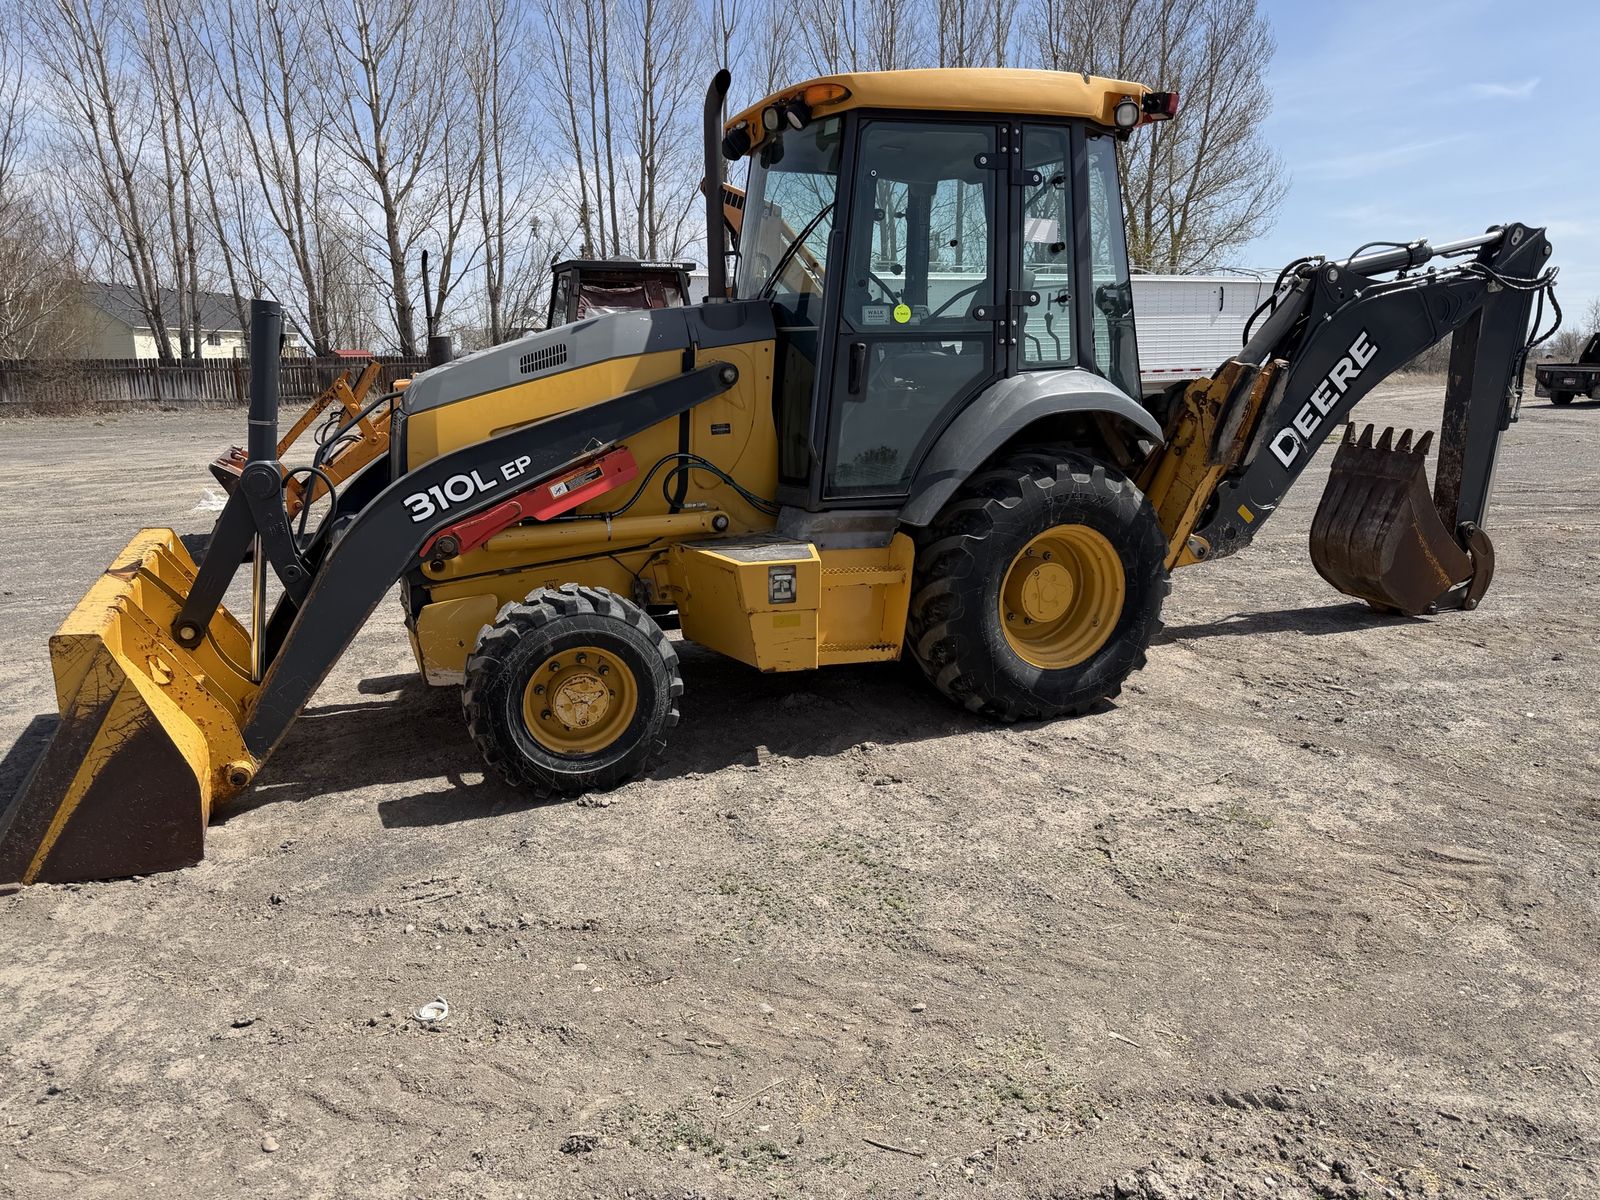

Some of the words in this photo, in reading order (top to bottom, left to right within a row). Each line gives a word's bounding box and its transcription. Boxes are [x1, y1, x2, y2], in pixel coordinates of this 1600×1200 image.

[1269, 331, 1378, 468] DEERE
[403, 470, 498, 523] 310L
[500, 455, 532, 481] EP
